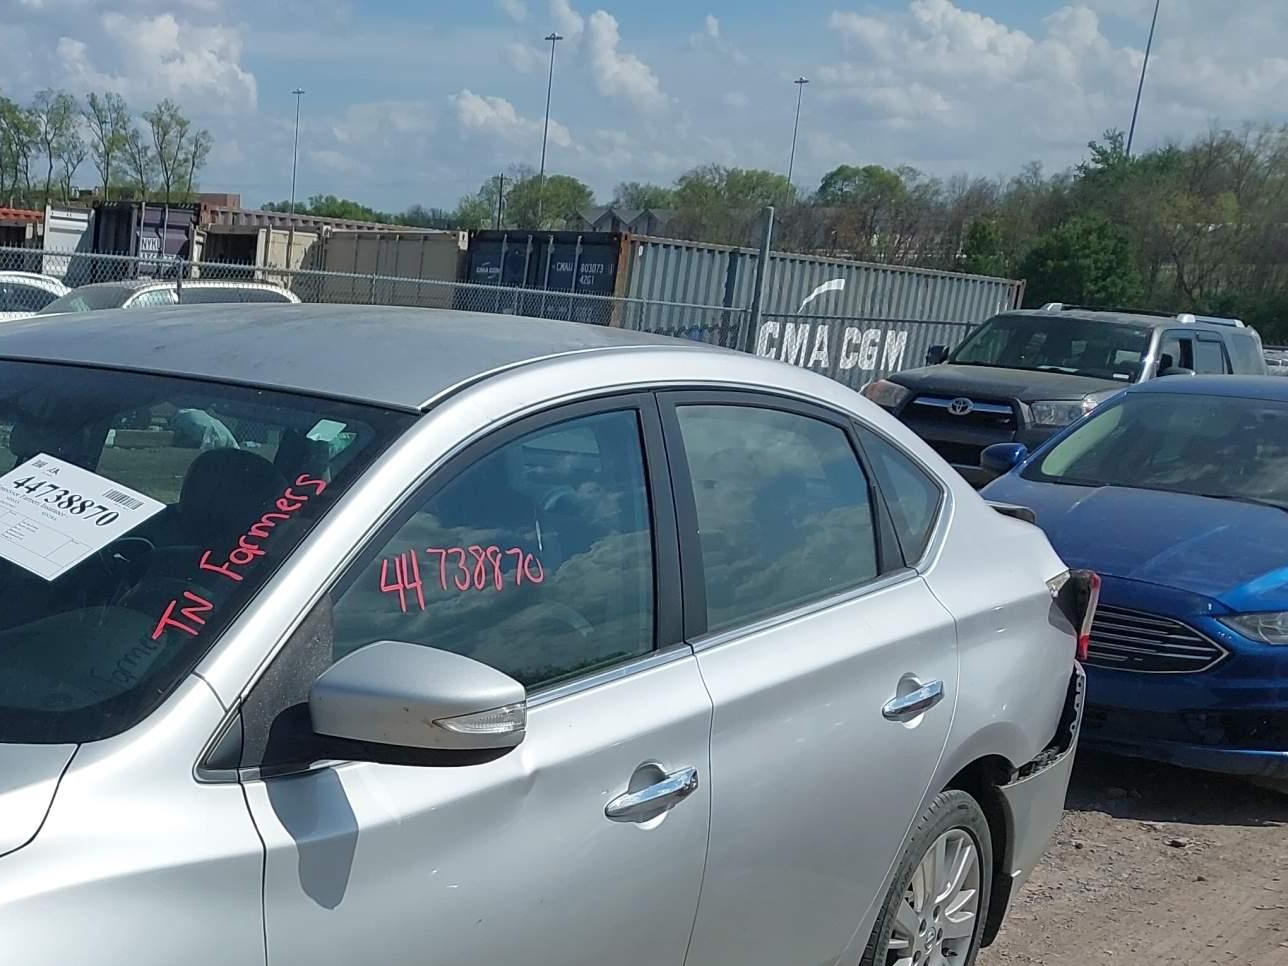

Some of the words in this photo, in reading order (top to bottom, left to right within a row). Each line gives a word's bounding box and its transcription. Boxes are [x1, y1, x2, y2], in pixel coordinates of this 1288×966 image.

[756, 320, 829, 369] CMA
[839, 326, 908, 372] CGM
[13, 475, 119, 527] 44738870
[152, 591, 214, 640] TN
[200, 473, 328, 581] Farmers
